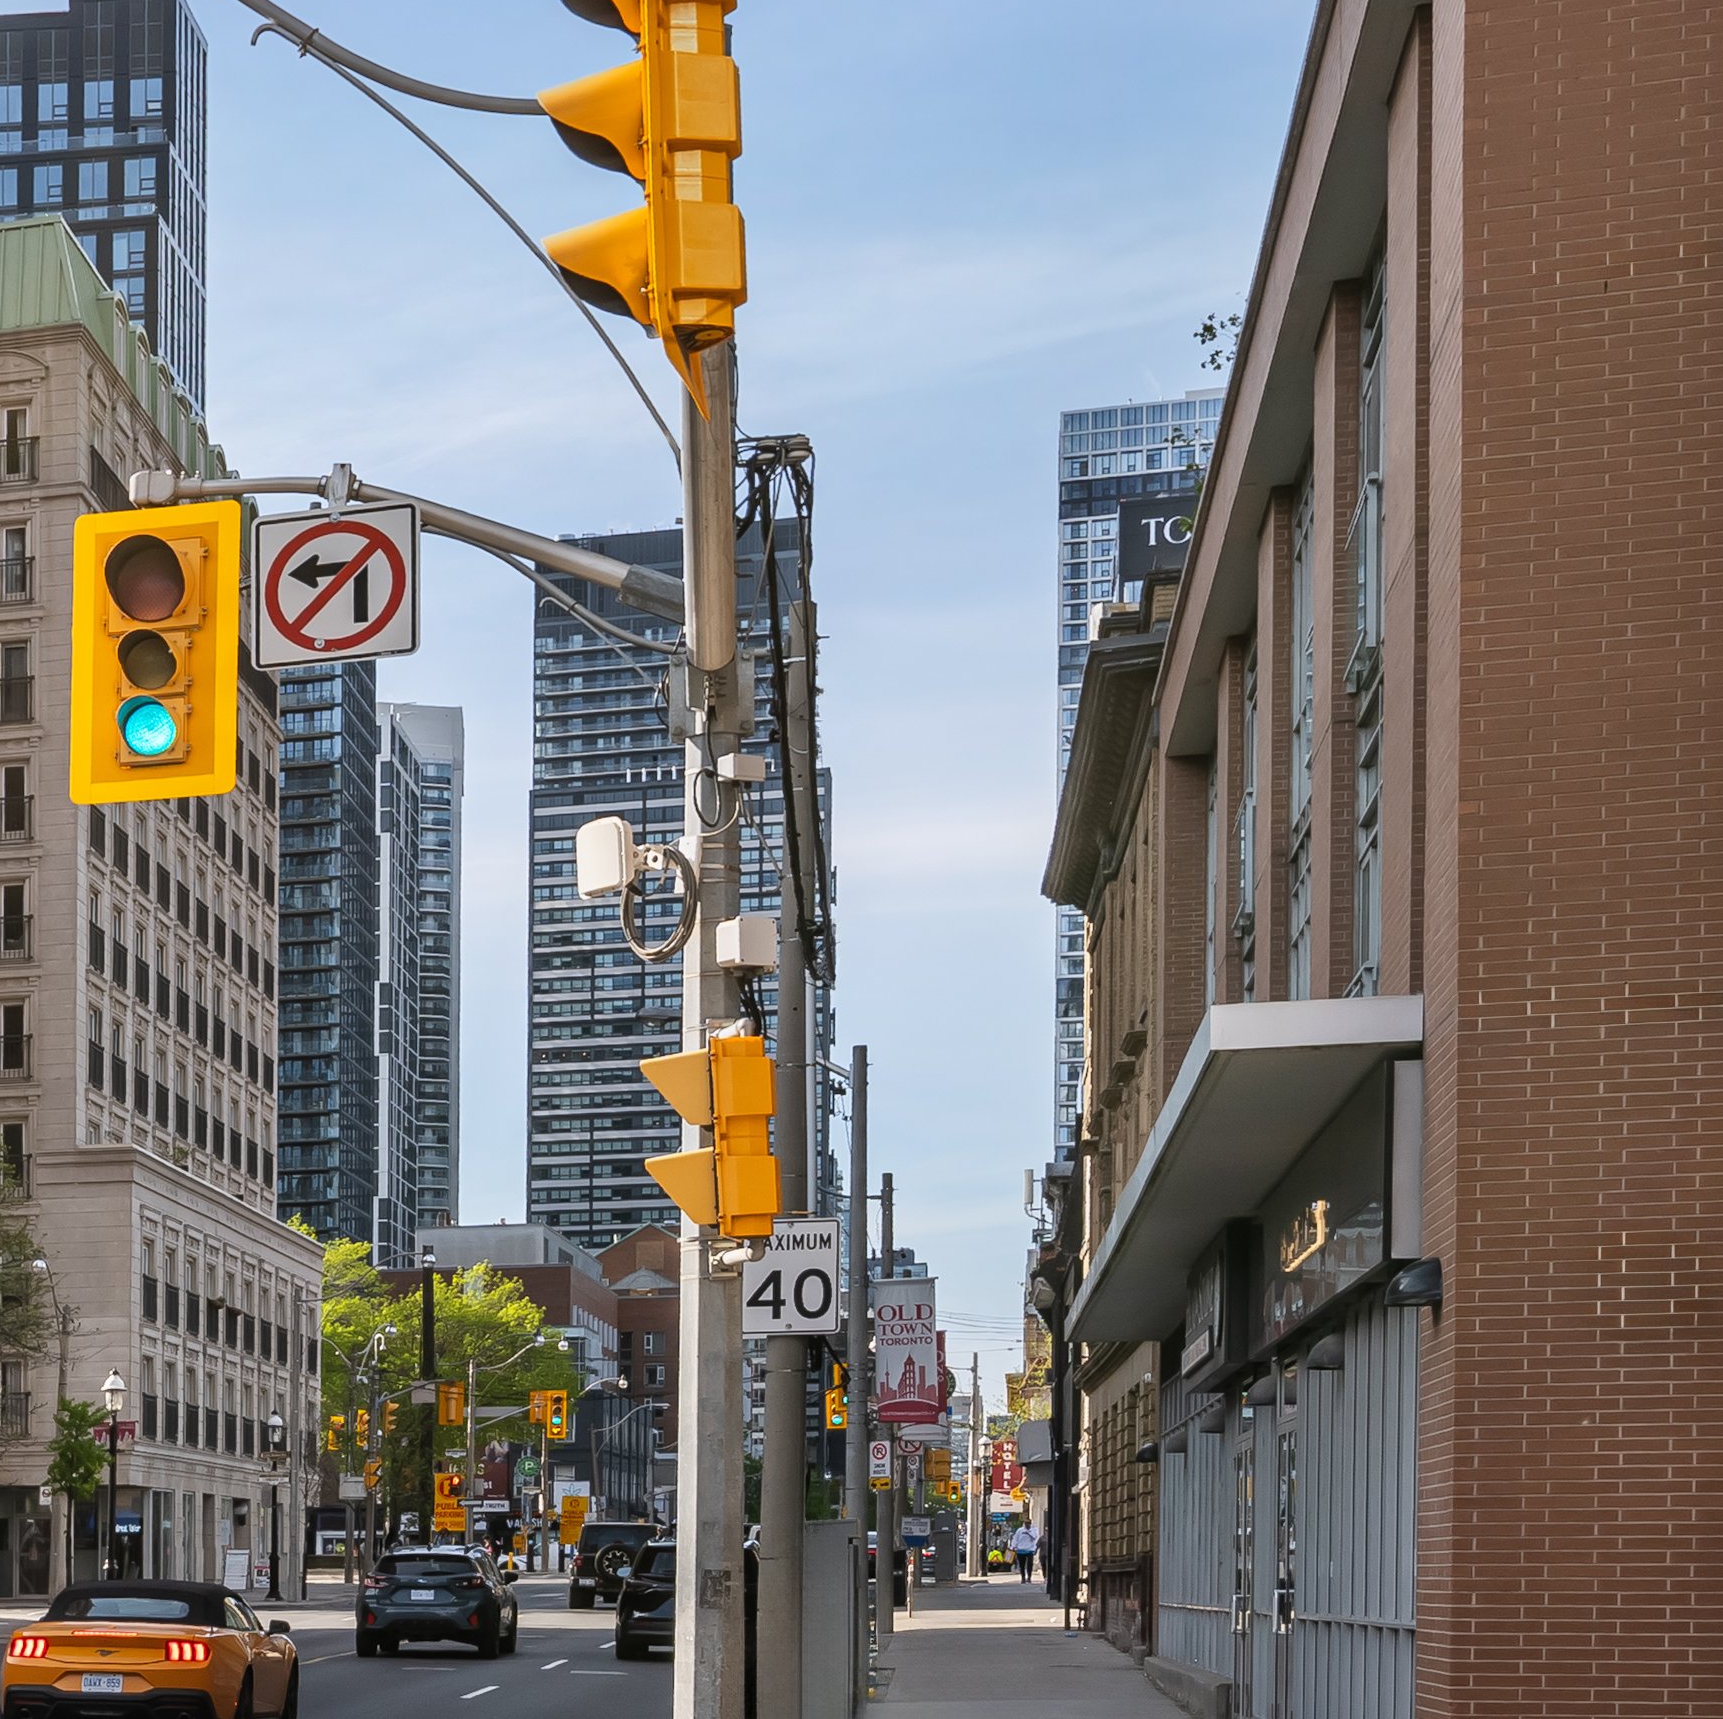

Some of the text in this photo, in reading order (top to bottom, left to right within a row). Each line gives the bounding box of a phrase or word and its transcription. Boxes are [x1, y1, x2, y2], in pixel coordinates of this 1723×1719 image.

[764, 1233, 832, 1251] AXIMUM
[746, 1268, 832, 1320] 40
[877, 1303, 933, 1322] OLD
[877, 1322, 933, 1336] TOWN
[879, 1336, 933, 1346] TORONTO
[1002, 1442, 1013, 1489] HOTEL
